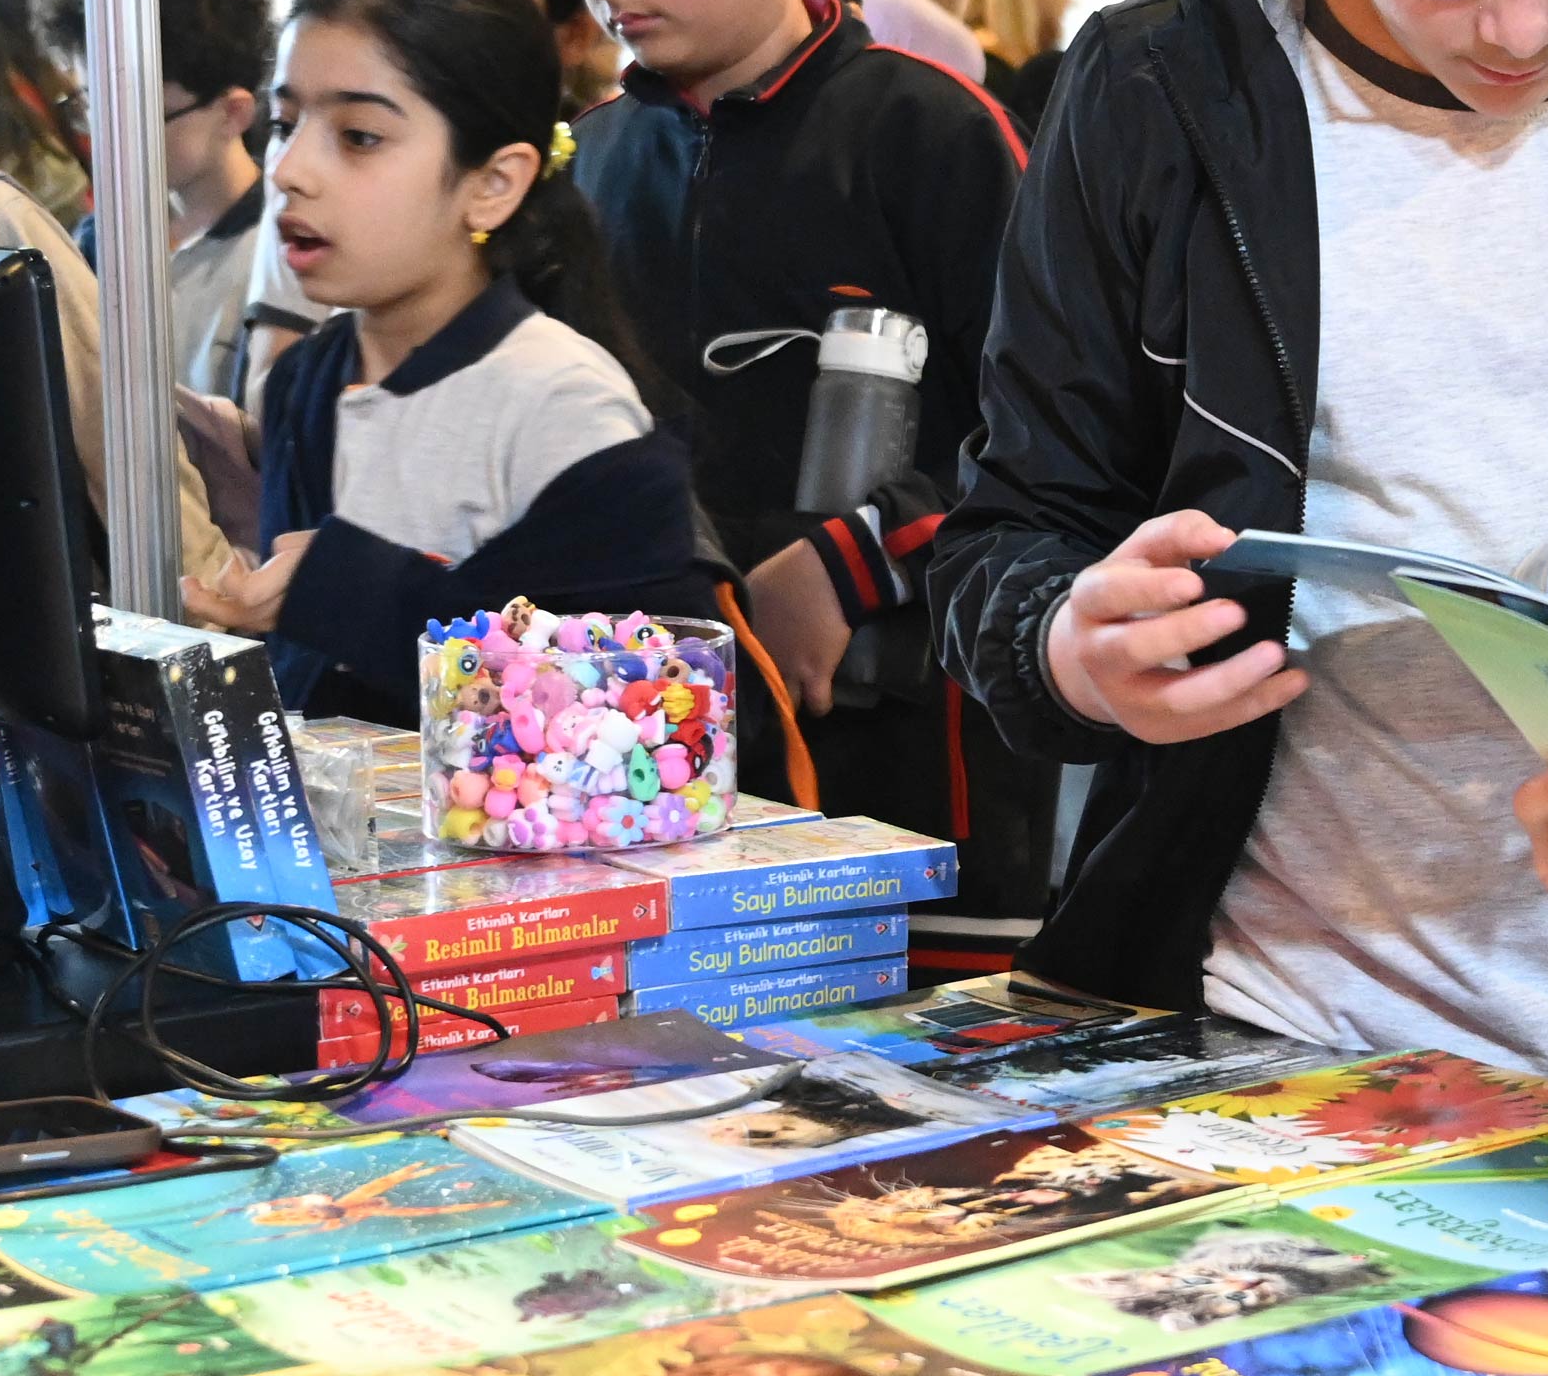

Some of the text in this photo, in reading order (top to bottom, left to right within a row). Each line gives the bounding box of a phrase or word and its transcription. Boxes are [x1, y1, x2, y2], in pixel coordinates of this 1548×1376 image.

[195, 759, 226, 838] Kartları
[203, 710, 258, 870] Gökbilim ve Uzay
[250, 759, 281, 837] Kartları
[257, 711, 313, 868] Gökbilim ve Uzay
[768, 865, 867, 885] Etkinlik Kartları
[732, 877, 900, 914] Sayı Bulmacaları
[467, 906, 570, 932] Etkinlik Kartları
[724, 922, 820, 944] Etkinlik Kartları
[424, 917, 619, 963] Resimli Bulmacalar
[688, 933, 853, 974] Sayı Bulmacaları
[421, 967, 525, 993] Etkinlik Kartları
[466, 975, 575, 1011] Bulmacalar
[730, 973, 823, 997] Etkinlik Kartları
[696, 984, 856, 1026] Sayı Bulmacaları
[417, 1029, 464, 1050] Etkinlik
